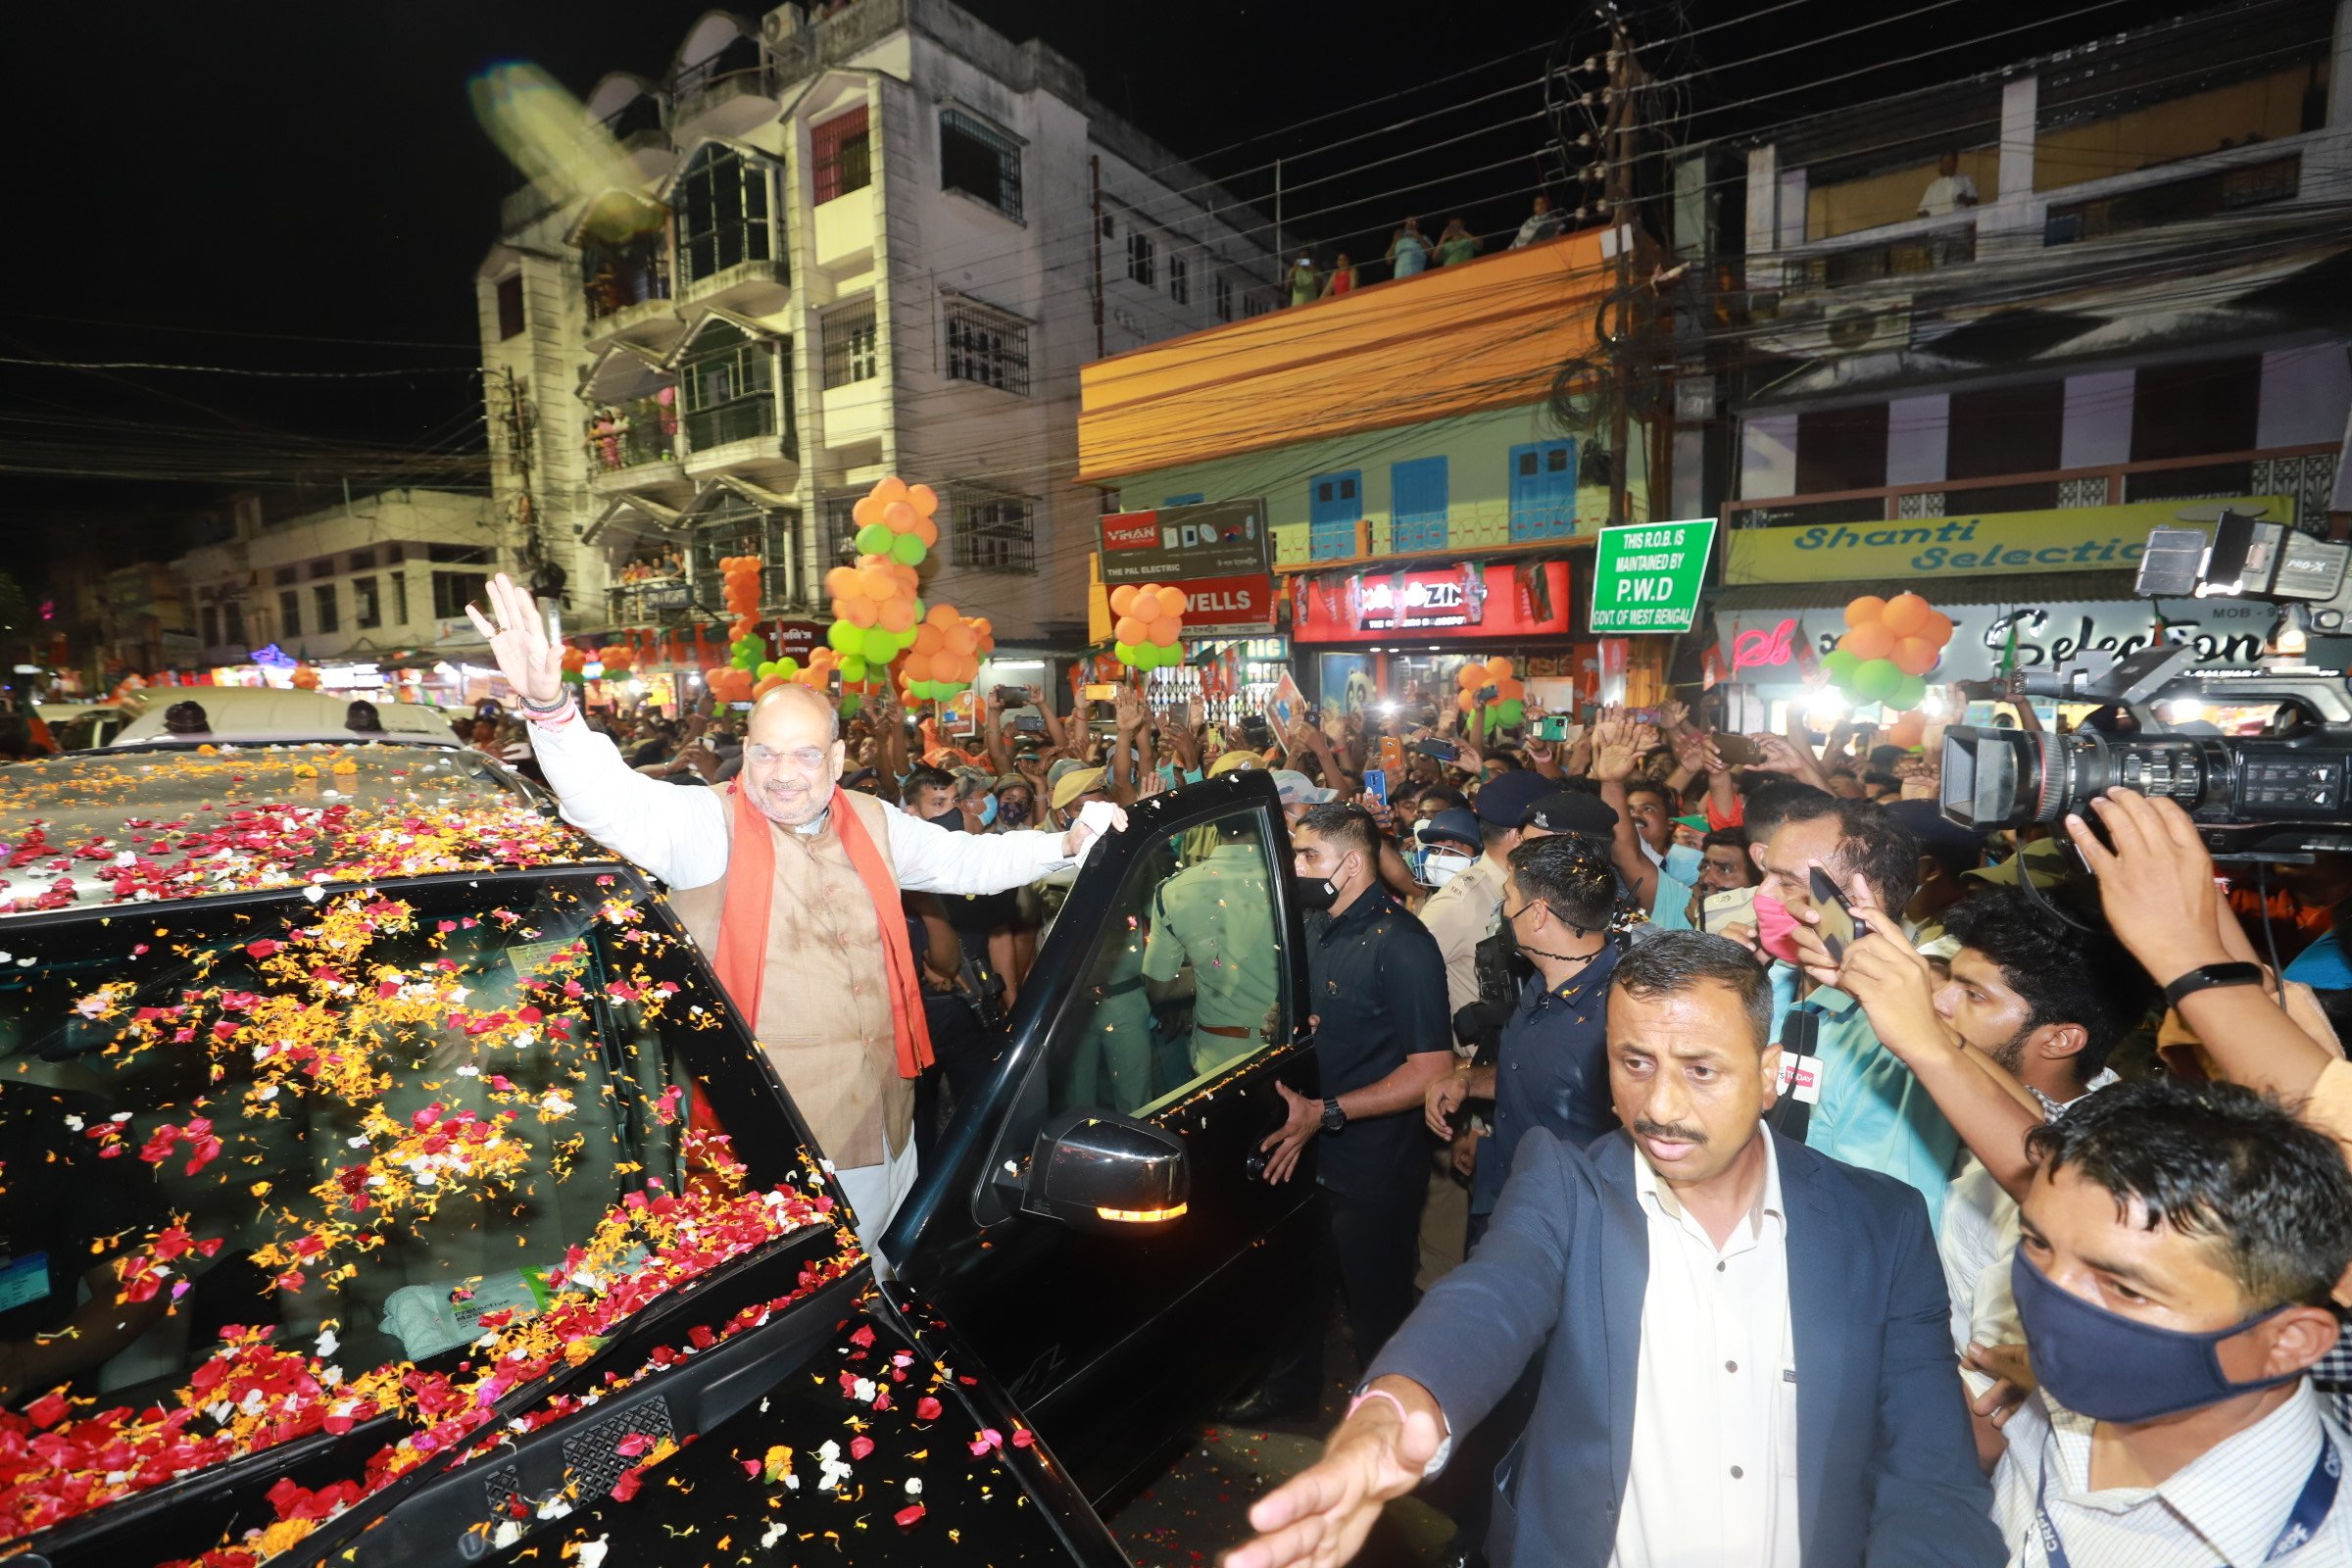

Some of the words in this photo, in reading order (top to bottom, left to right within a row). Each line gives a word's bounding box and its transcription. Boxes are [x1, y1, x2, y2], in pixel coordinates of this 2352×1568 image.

[1623, 533, 1642, 549] THIS
[1644, 530, 1672, 548] R.O.B.
[1674, 529, 1686, 545] IS
[1794, 519, 1980, 551] Shanti
[1615, 554, 1669, 572] MAINTAINED
[1669, 553, 1686, 569] BY
[1912, 539, 2146, 570] Selectio
[1141, 564, 1181, 573] ELECTRIC
[2287, 560, 2327, 571] PRO-X
[1616, 577, 1674, 602] P.W.D
[1593, 610, 1615, 625] GOVT.
[1617, 610, 1629, 625] OF
[1629, 609, 1652, 625] WEST
[1653, 608, 1690, 624] BENGAL
[2213, 608, 2251, 618] MOB
[1985, 609, 2266, 667] Selecon
[455, 1298, 511, 1317] Protective
